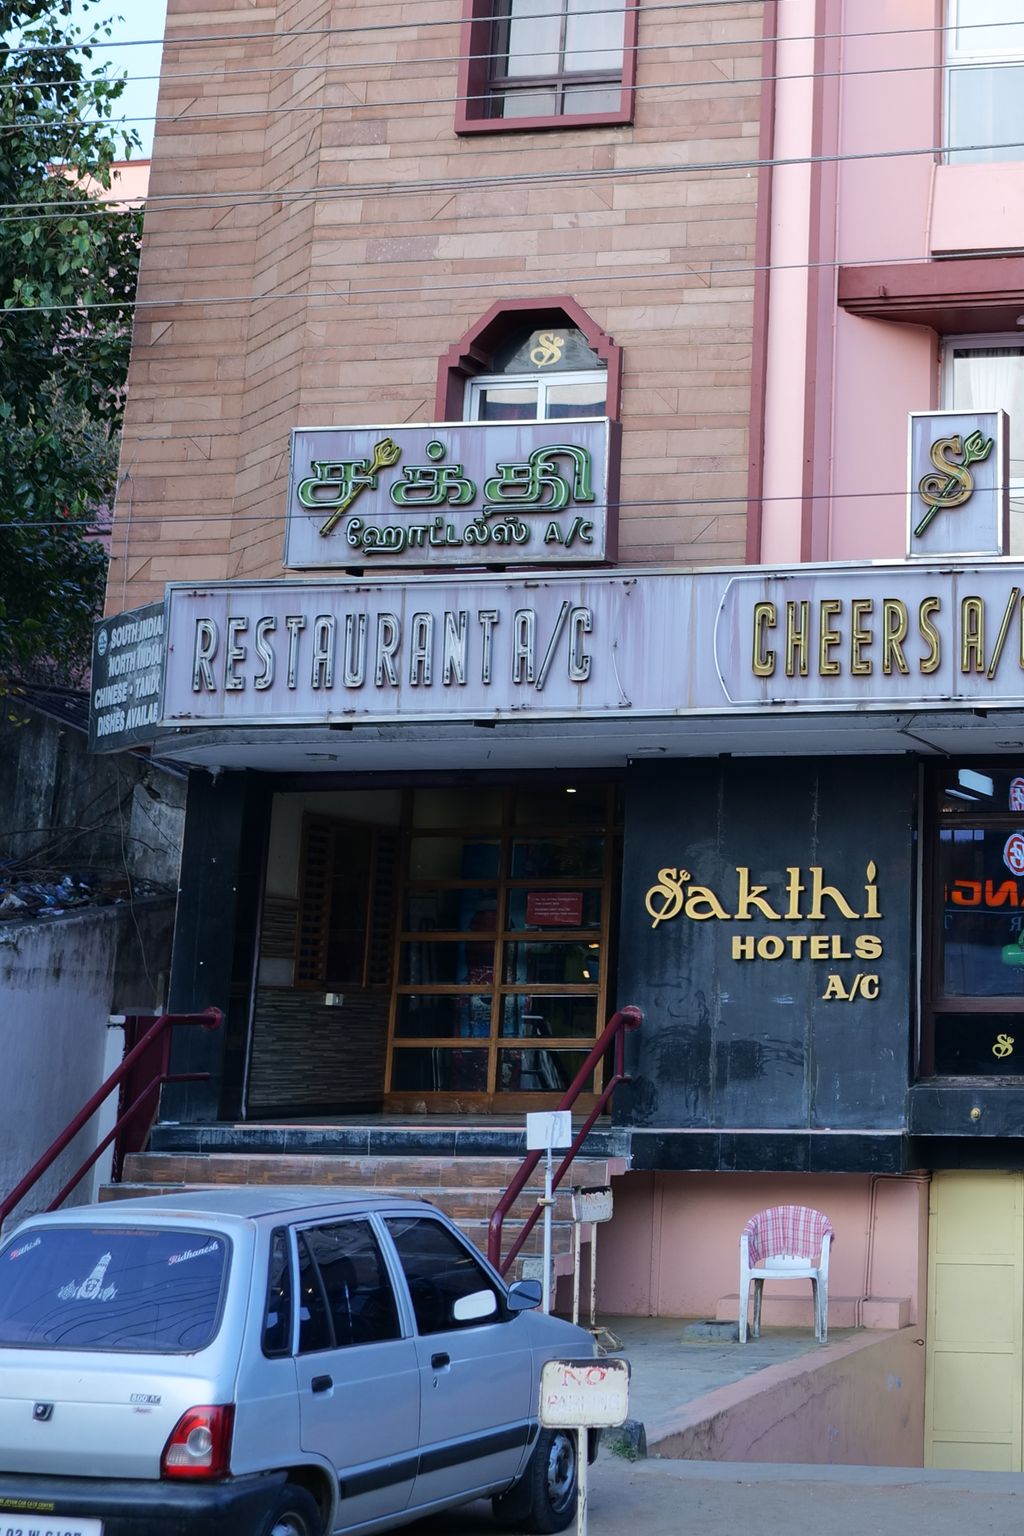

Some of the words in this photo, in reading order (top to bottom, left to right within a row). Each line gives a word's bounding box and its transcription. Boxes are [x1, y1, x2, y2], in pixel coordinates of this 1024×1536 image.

[298, 439, 596, 517] சக்தி
[545, 517, 594, 547] A/C
[110, 621, 137, 649] SOUTH
[192, 609, 500, 692] RESTAURANT
[512, 599, 593, 691] A/C
[751, 596, 941, 677] CHEERS
[108, 650, 136, 677] NORTH
[94, 681, 128, 710] CHINESE
[97, 710, 125, 738] DISHES
[645, 860, 882, 929] Sakthi
[732, 935, 882, 960] HOTELS
[822, 972, 880, 1002] A/C
[562, 1366, 606, 1386] NO
